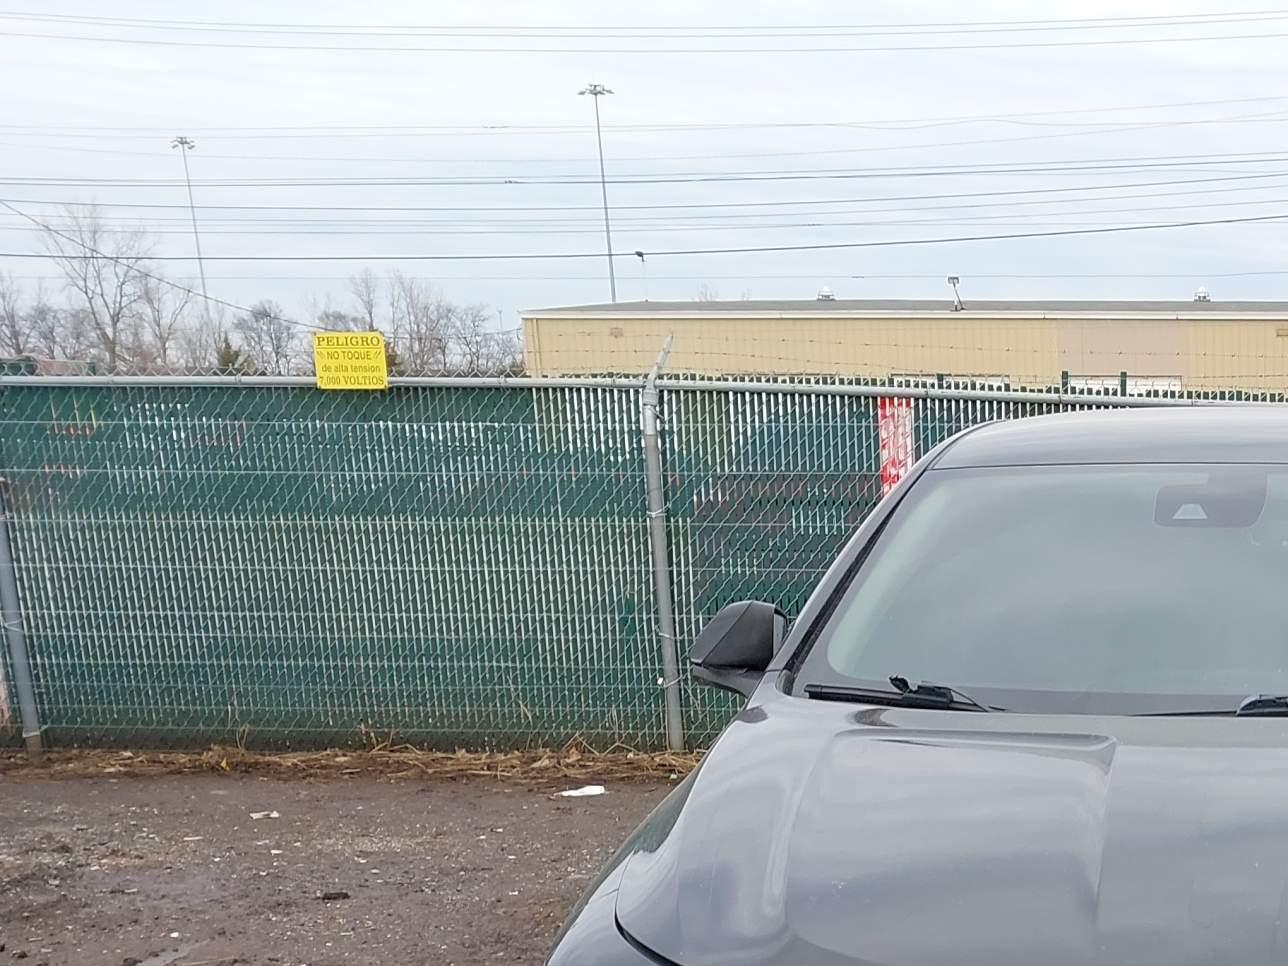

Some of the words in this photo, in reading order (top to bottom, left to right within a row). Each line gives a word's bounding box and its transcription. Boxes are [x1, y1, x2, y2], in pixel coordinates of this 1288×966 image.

[317, 336, 380, 346] PELIGRO
[326, 351, 340, 360] NO
[342, 351, 372, 360] TOQUE
[321, 364, 332, 373] de
[333, 364, 348, 373] alta
[350, 364, 381, 373] tension
[342, 376, 385, 386] VOLTIOS
